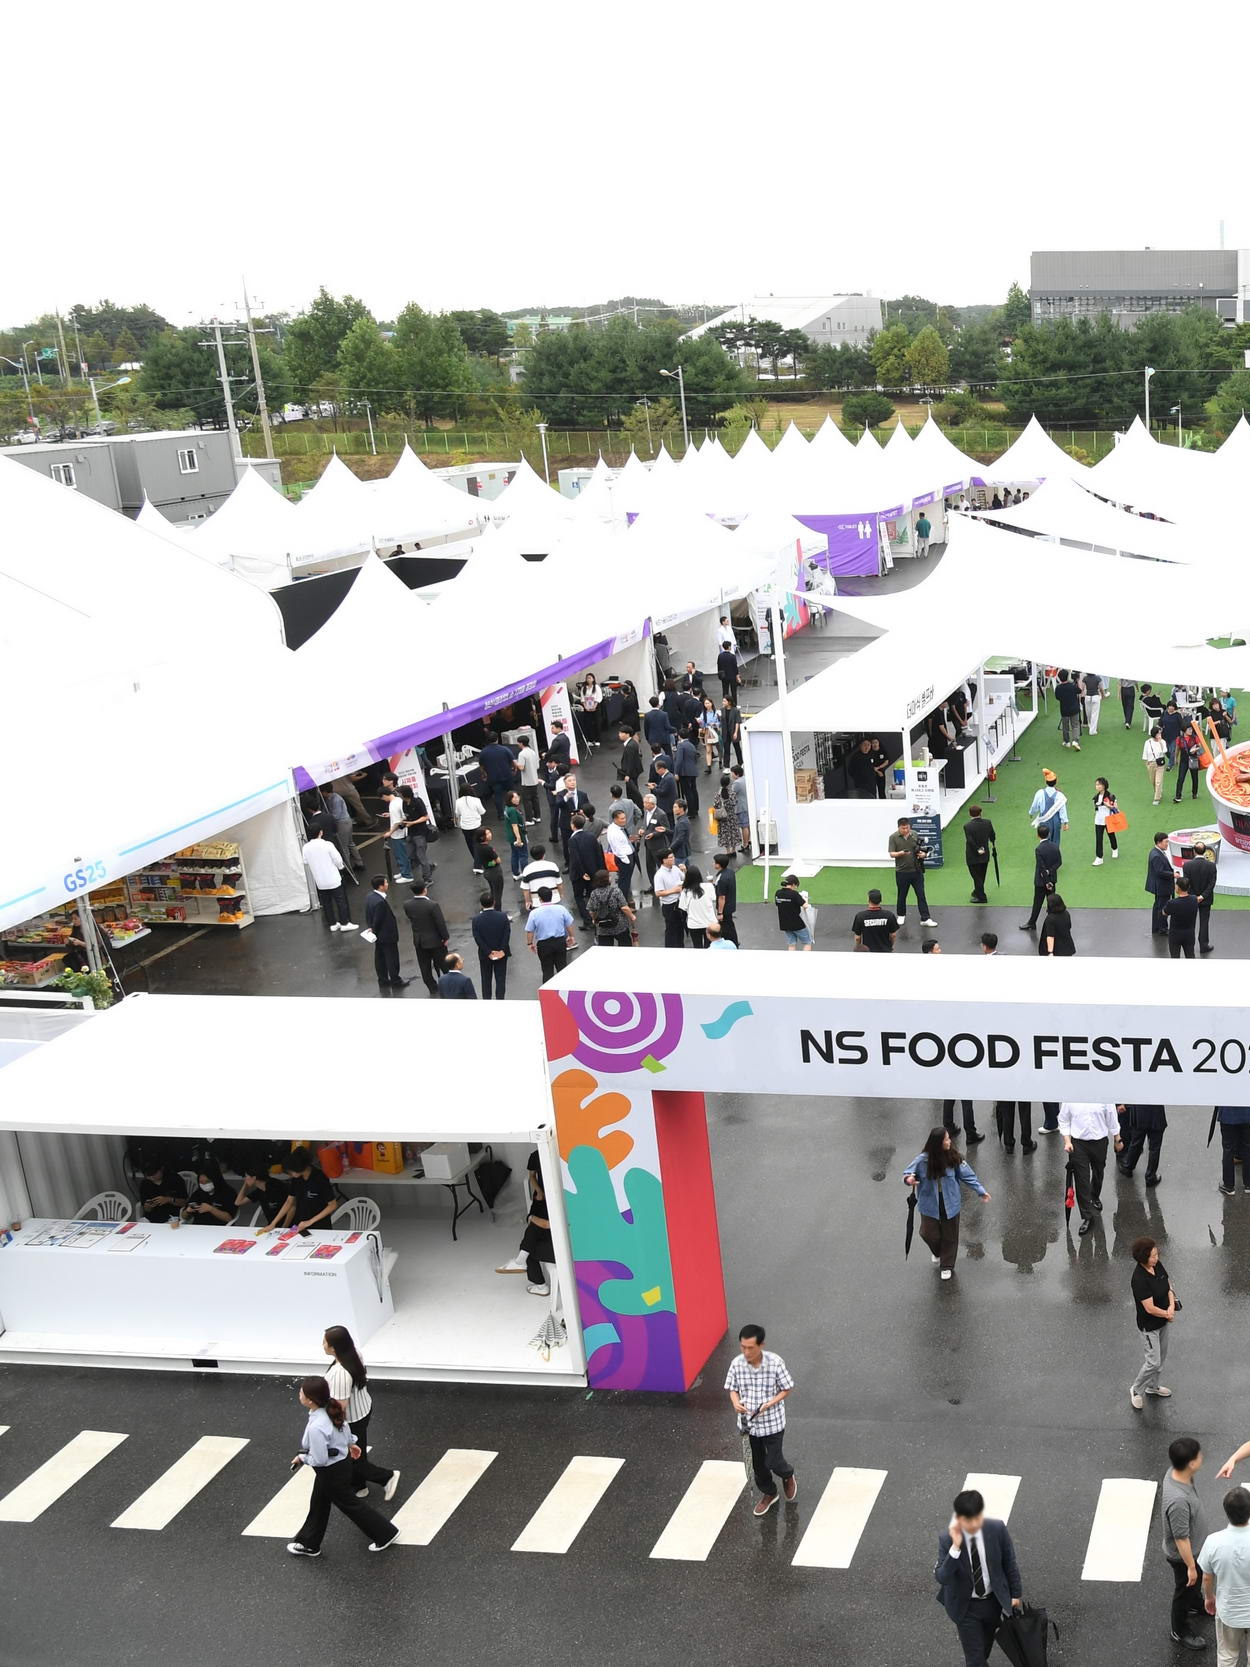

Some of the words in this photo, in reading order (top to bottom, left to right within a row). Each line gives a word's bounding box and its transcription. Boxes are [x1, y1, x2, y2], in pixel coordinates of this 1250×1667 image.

[63, 860, 106, 892] GS25
[864, 919, 888, 927] SECURITY
[800, 1029, 869, 1065] NS
[880, 1031, 1021, 1069] FOOD
[1033, 1035, 1183, 1073] FESTA
